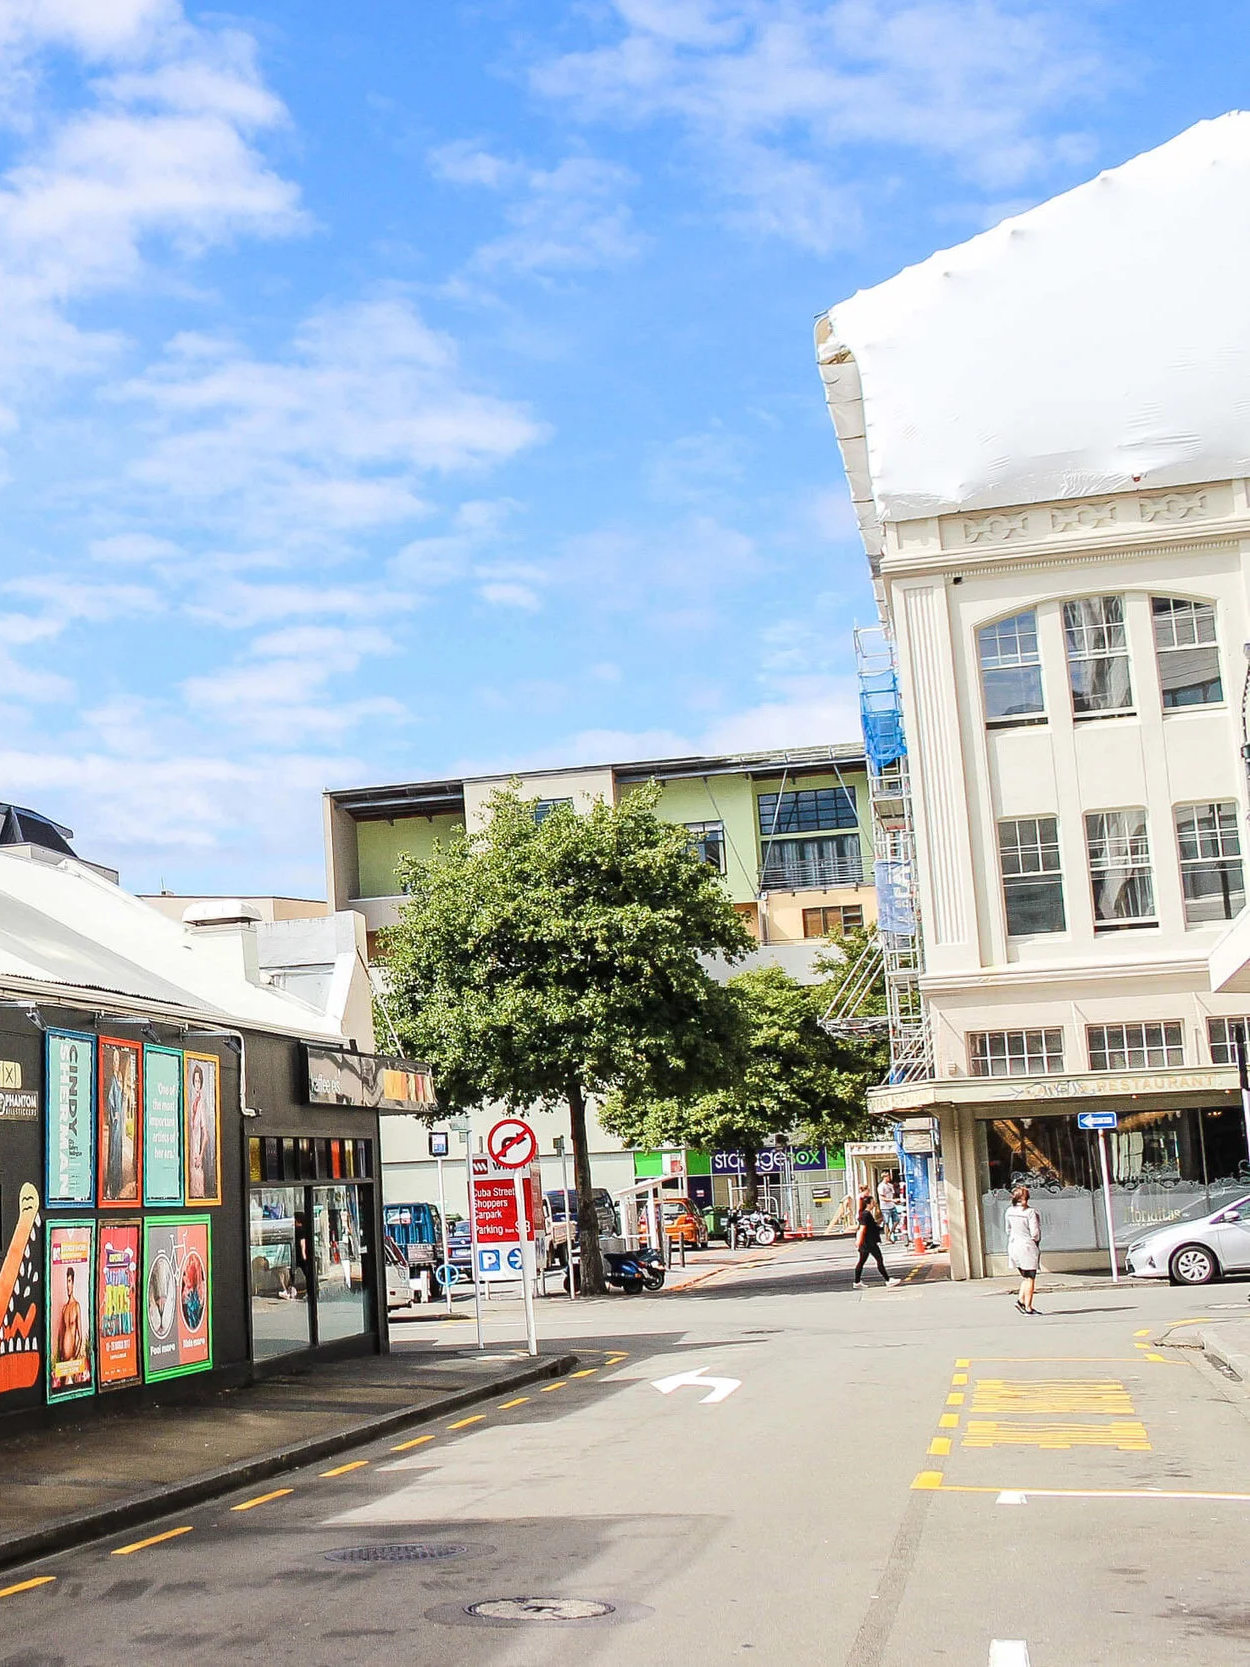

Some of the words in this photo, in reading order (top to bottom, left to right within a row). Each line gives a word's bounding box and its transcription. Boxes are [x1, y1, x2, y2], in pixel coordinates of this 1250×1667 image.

[69, 1045, 78, 1136] CINDY
[1098, 1073, 1217, 1093] RESTAURANT
[5, 1094, 37, 1108] PHANTOM
[59, 1043, 70, 1195] SHERMAN
[493, 1187, 515, 1197] Street
[474, 1199, 508, 1209] Shoppers
